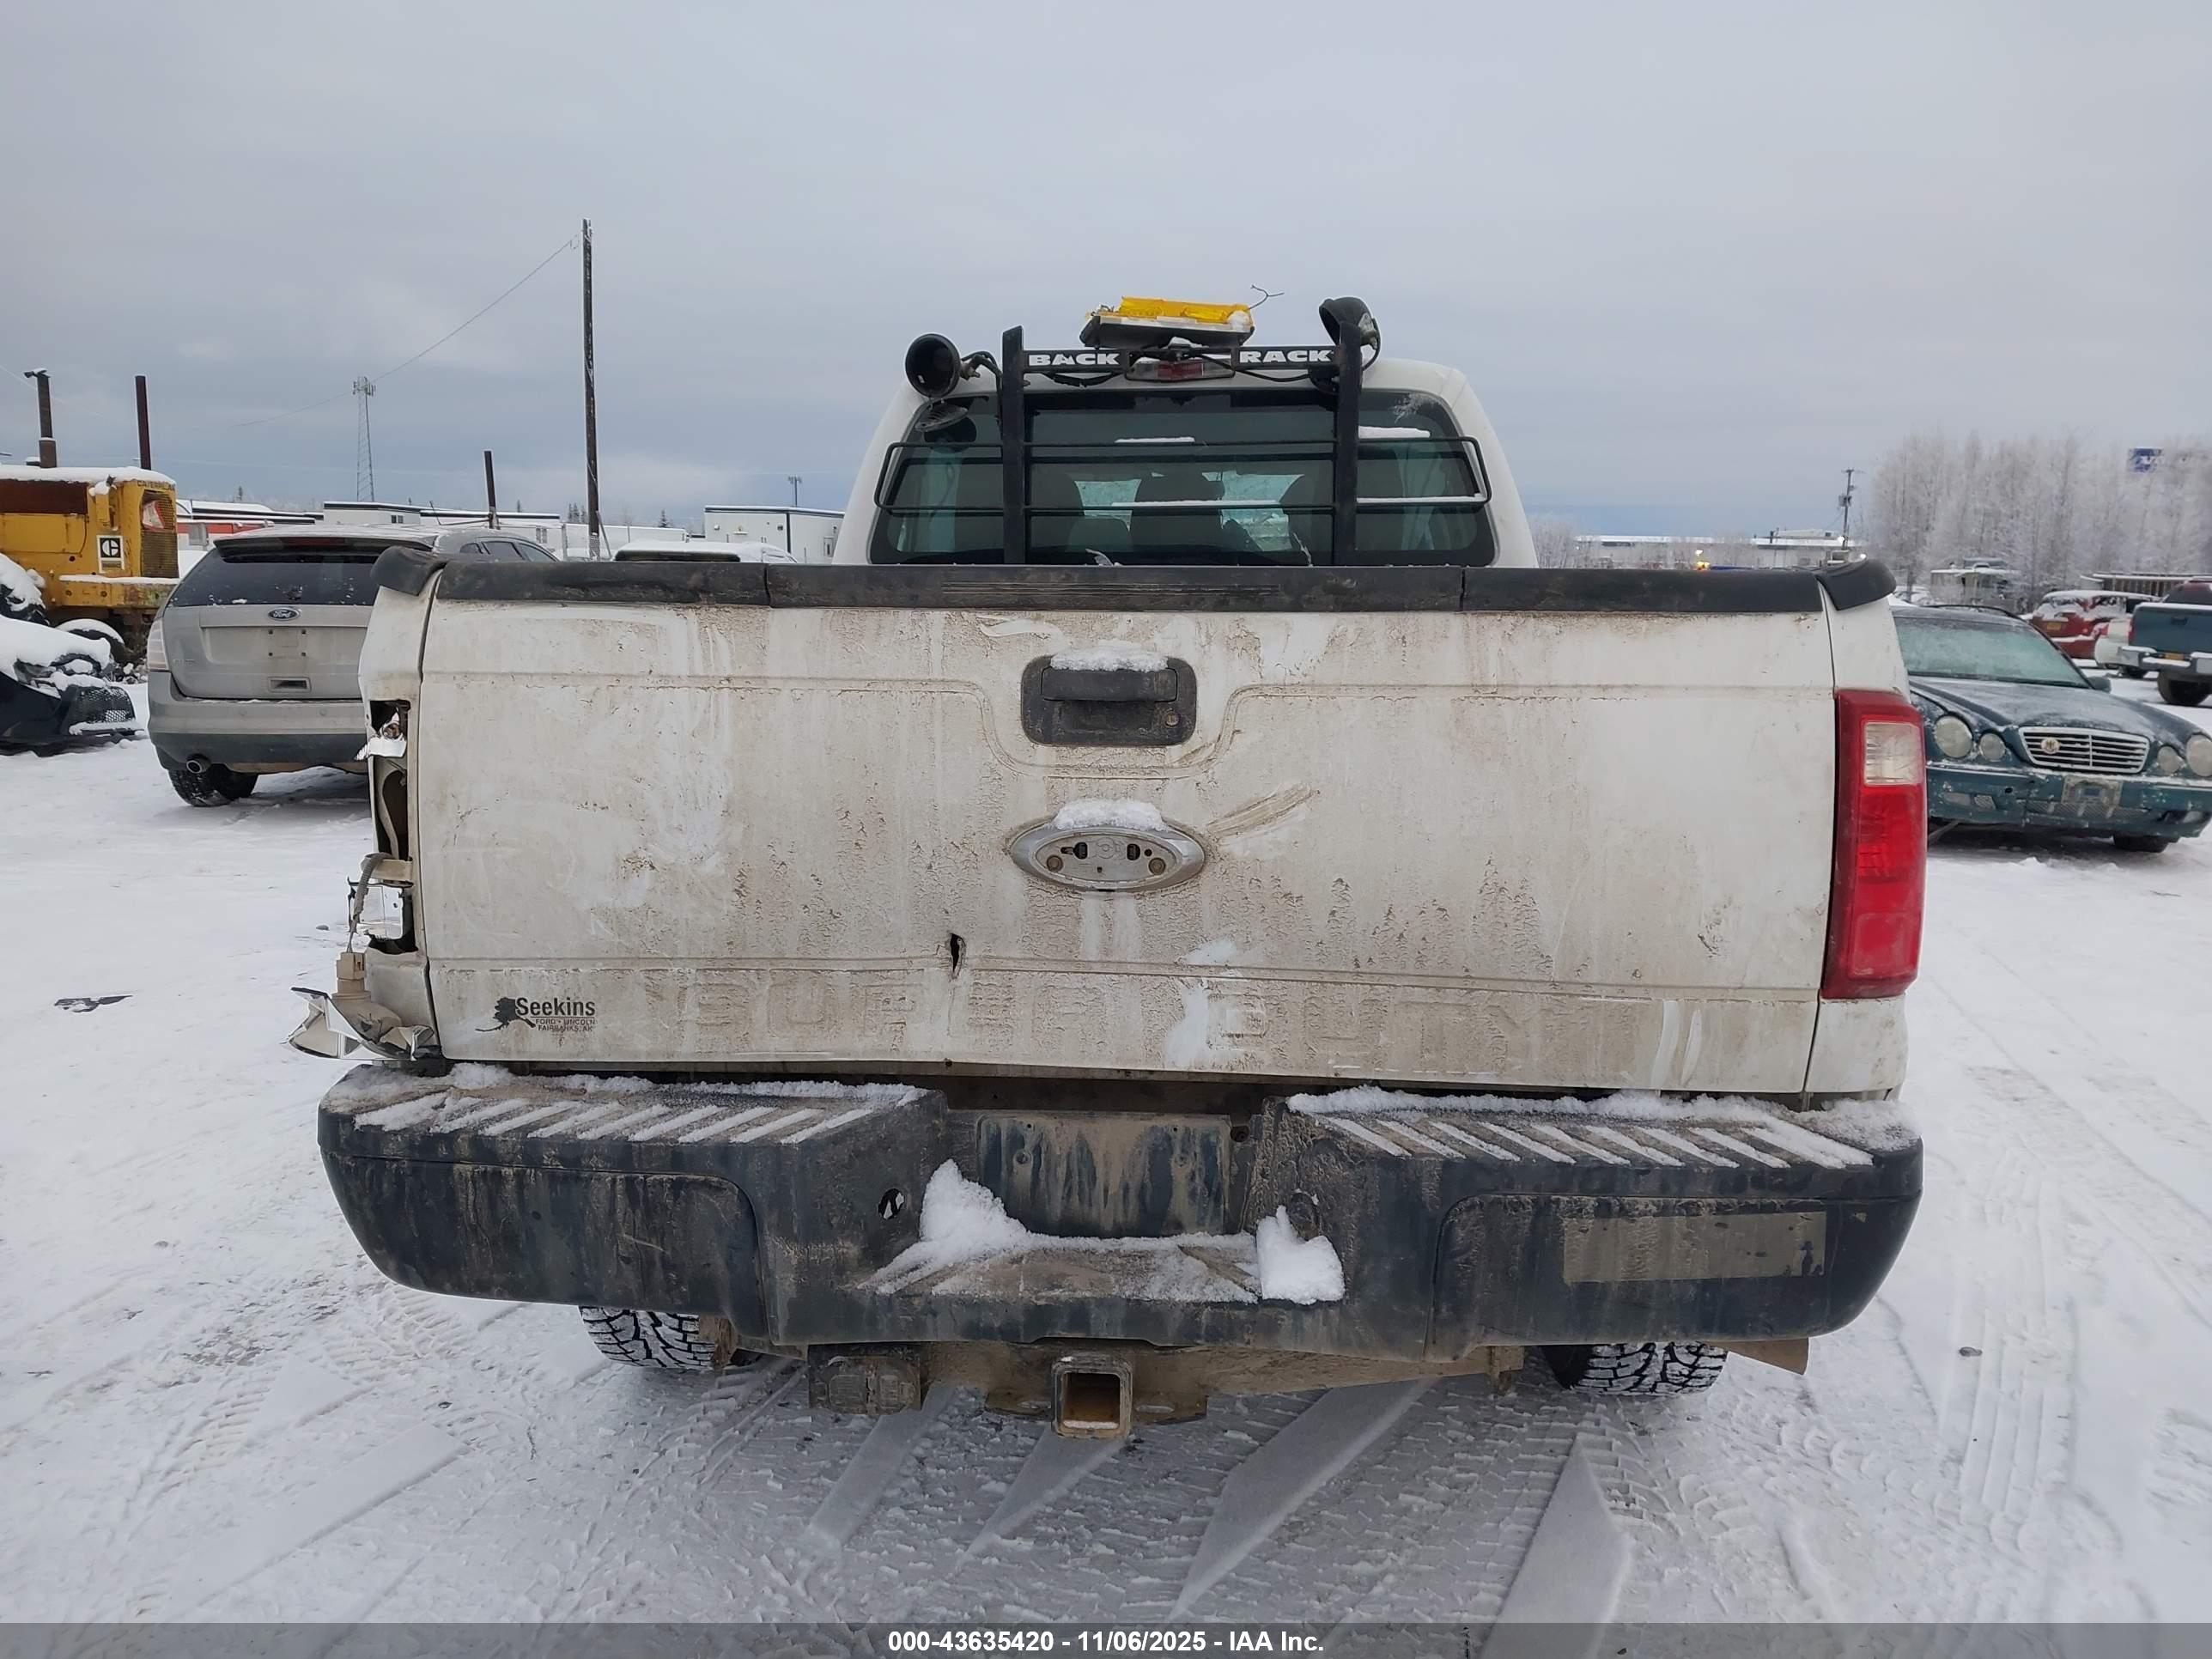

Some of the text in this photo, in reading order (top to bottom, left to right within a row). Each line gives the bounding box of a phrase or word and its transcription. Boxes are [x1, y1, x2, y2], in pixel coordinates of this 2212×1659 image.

[1029, 349, 1332, 366] BACK RACK
[516, 997, 596, 1017] Seekins
